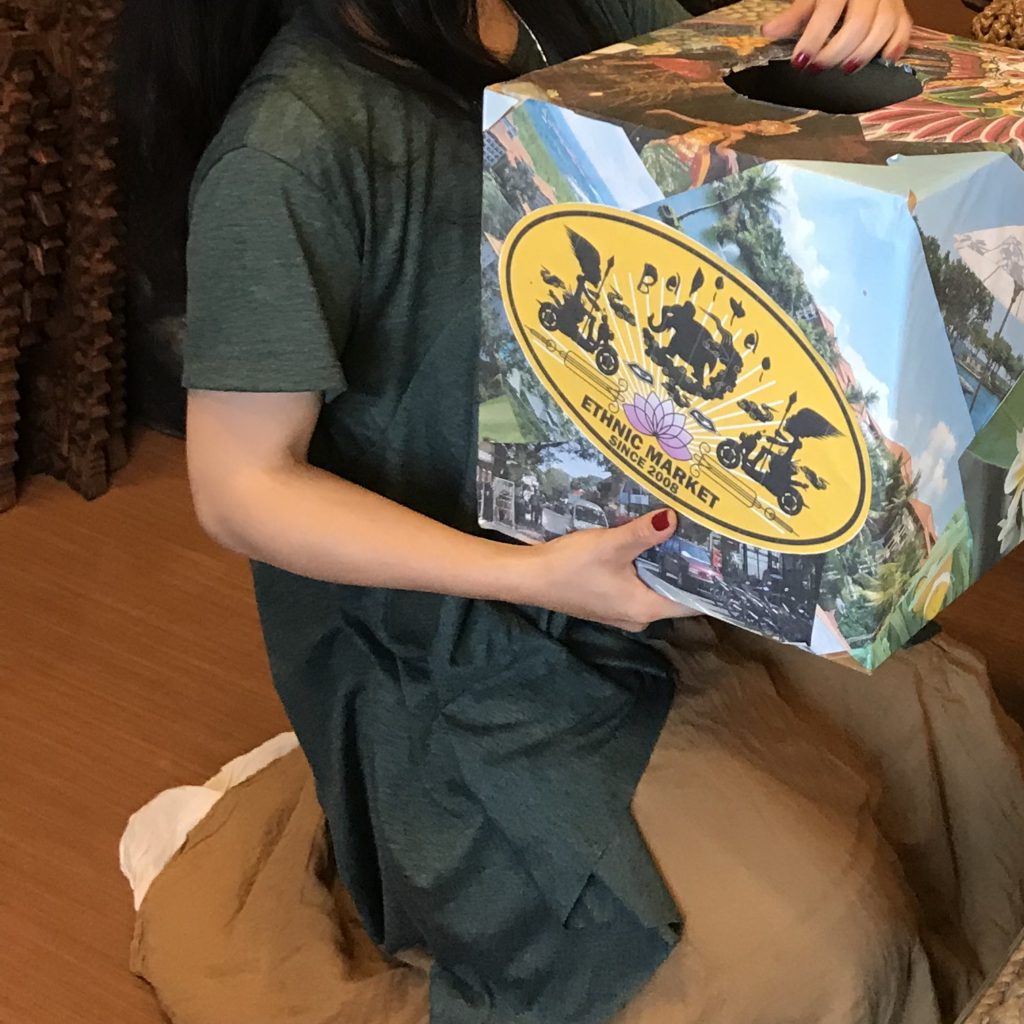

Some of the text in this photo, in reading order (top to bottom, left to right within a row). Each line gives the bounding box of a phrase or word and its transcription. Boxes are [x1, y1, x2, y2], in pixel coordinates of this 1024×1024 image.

[581, 394, 720, 509] ETHNIC MARKET
[608, 435, 680, 495] SINCE 2008
